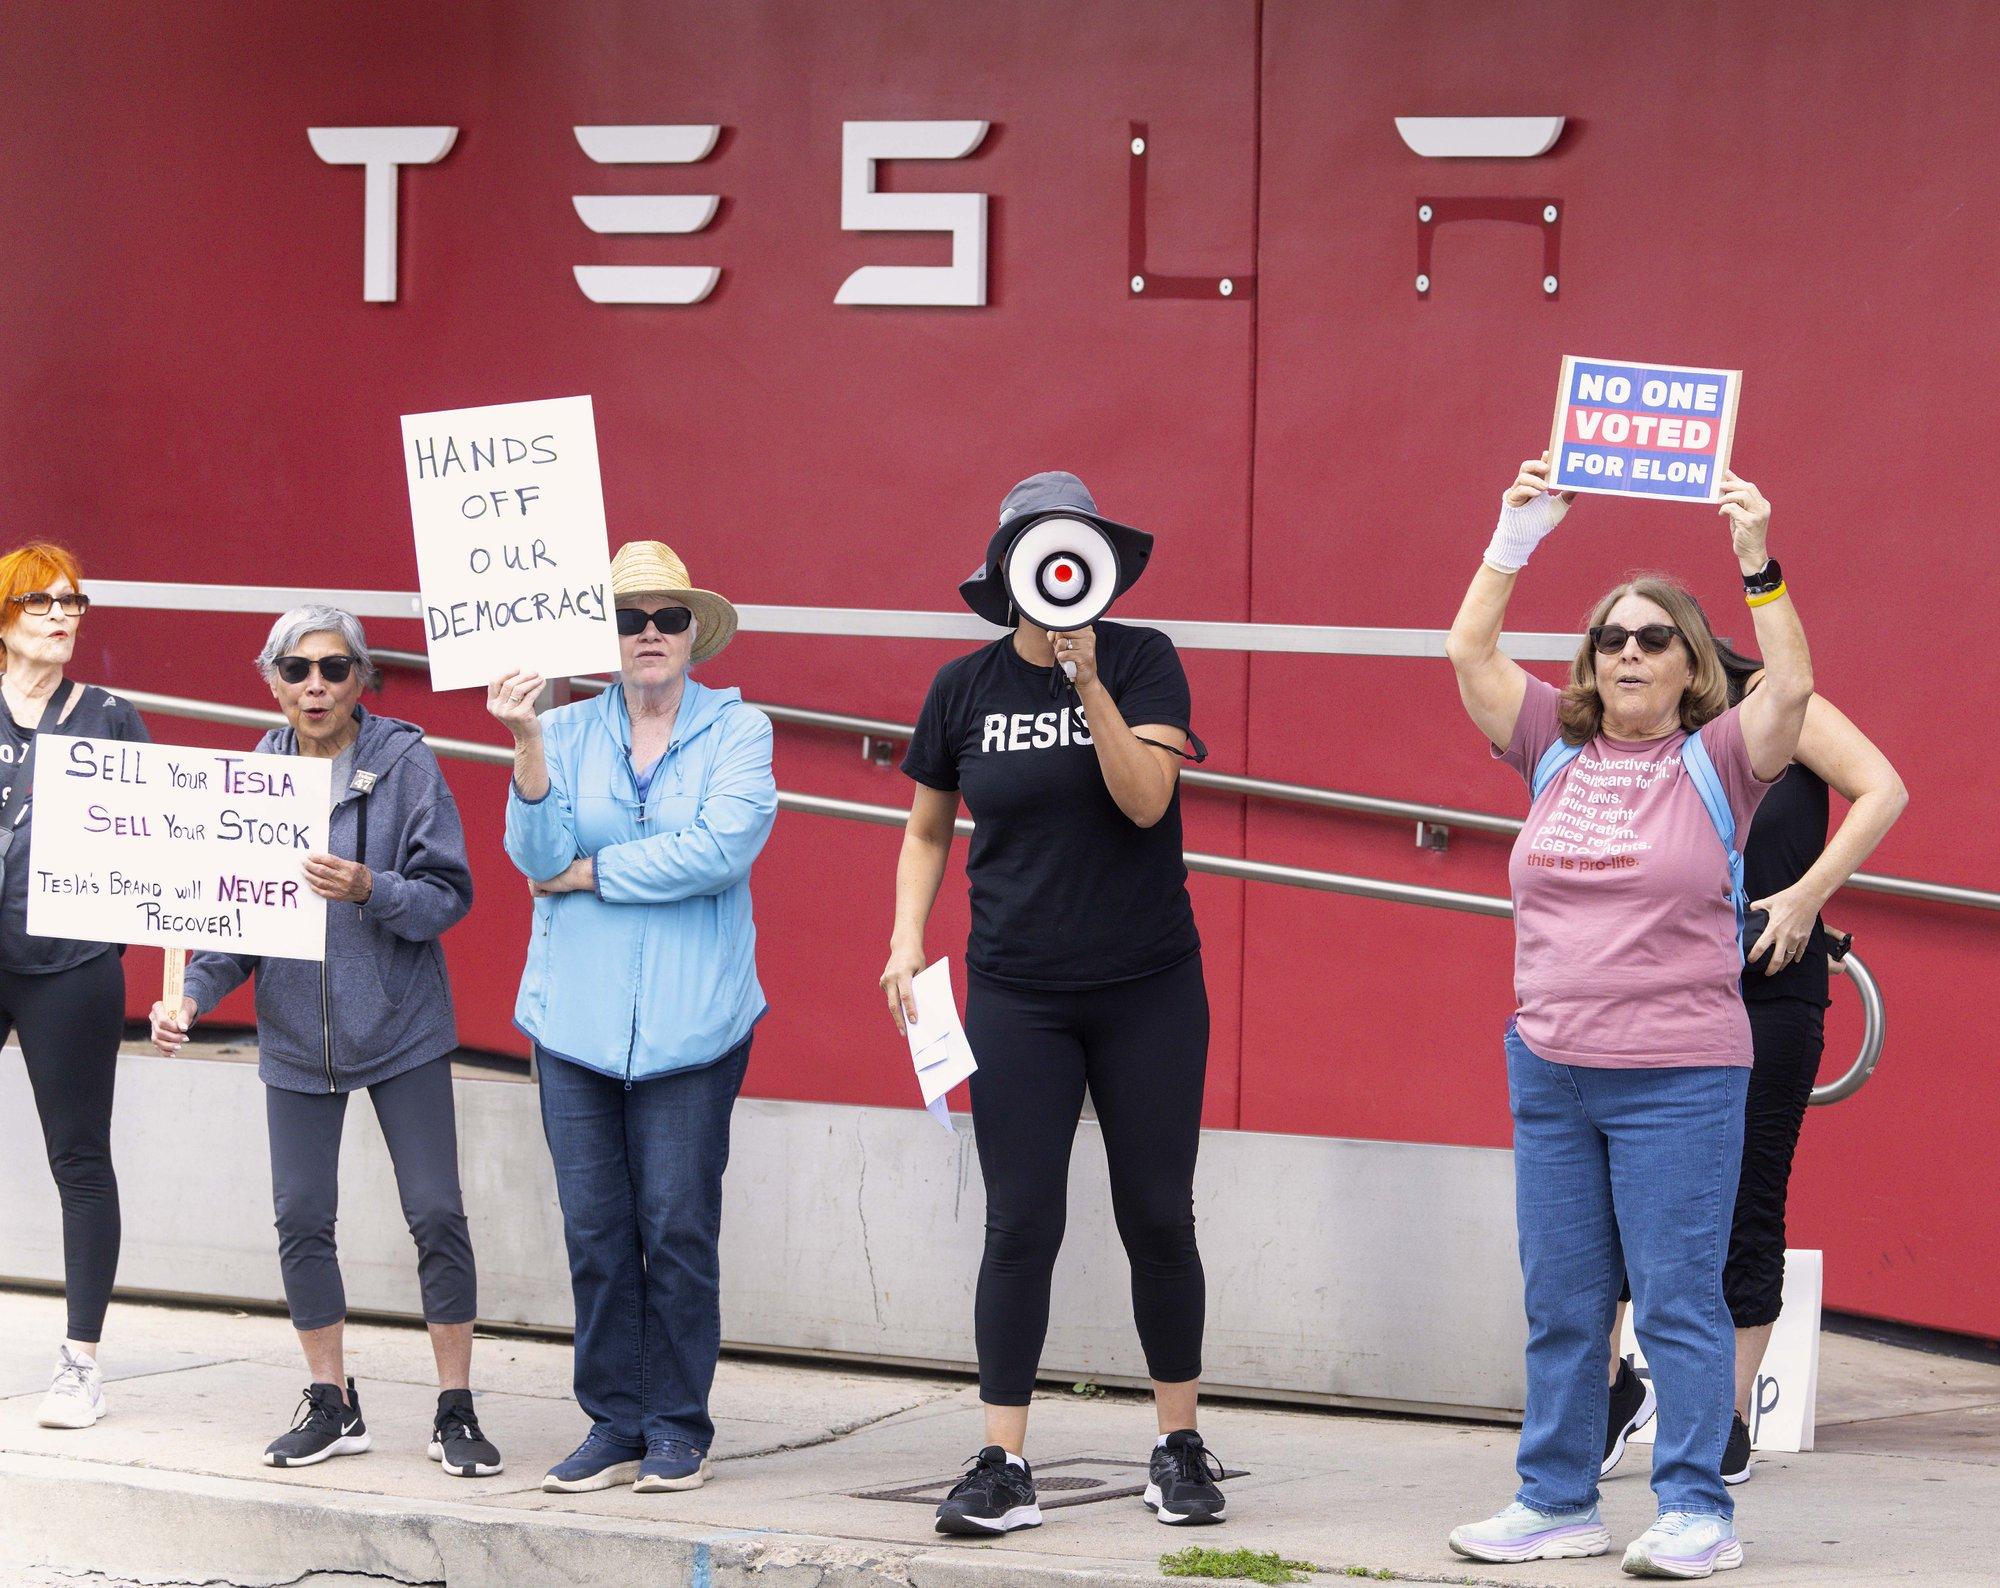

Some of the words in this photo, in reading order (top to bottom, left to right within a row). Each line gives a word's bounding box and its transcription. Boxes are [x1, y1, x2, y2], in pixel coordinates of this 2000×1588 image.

[1577, 373, 1632, 404] NO
[1641, 380, 1718, 412] ONE
[1575, 410, 1711, 449] VOTED
[415, 435, 557, 479] HANDS
[1566, 451, 1624, 477] FOR
[1631, 458, 1707, 484] ELON
[461, 486, 540, 519] OFF
[470, 539, 557, 574] OUR
[427, 583, 607, 641] DEMOCRACY
[981, 705, 1095, 753] RESIS
[65, 741, 147, 785] SELL
[214, 757, 295, 797] TESLA
[83, 805, 152, 837] SELL
[216, 810, 310, 849] STOCK
[1527, 853, 1555, 868] this
[1560, 856, 1574, 870] is
[1579, 855, 1640, 873] pro-life.
[110, 871, 162, 897] BRAND
[218, 875, 298, 908] NEVER
[137, 902, 242, 938] RECOVER!
